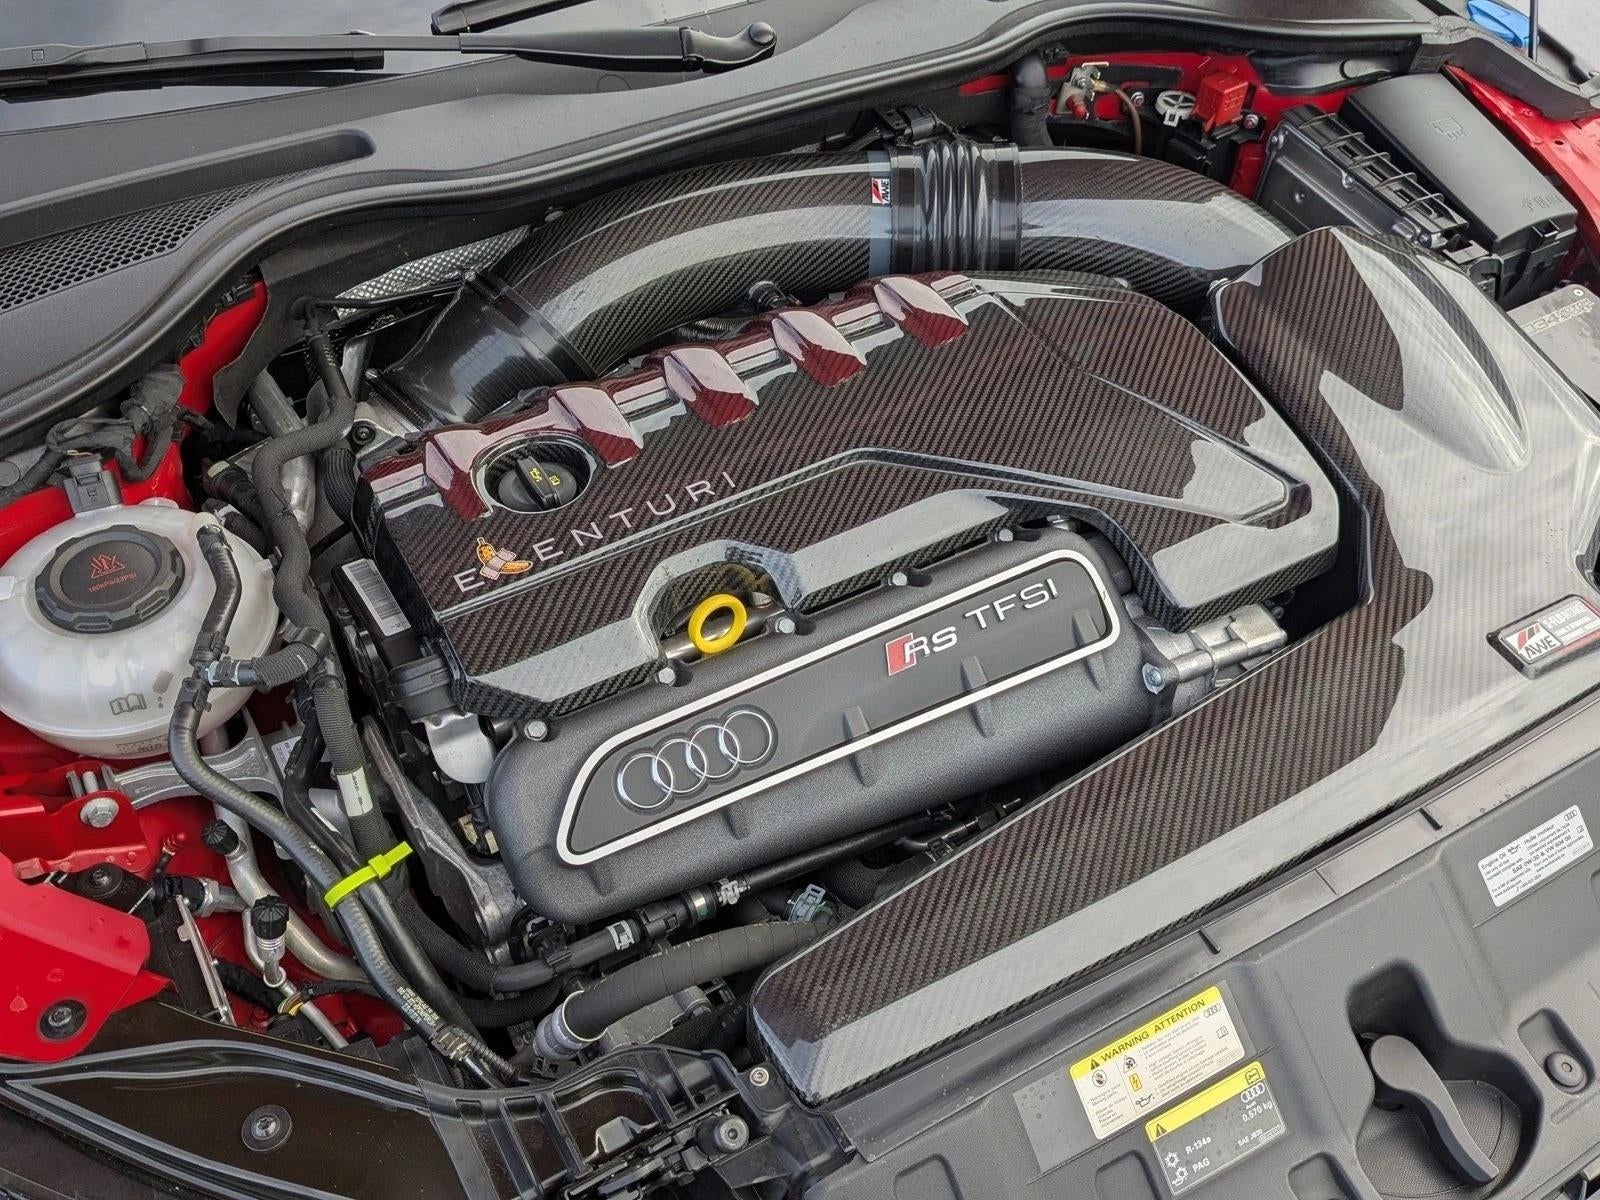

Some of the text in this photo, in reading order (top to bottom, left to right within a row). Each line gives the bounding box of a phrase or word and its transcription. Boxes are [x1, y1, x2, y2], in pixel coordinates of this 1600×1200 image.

[453, 471, 736, 592] EENTURI
[902, 577, 1059, 664] RS TFSI
[1523, 635, 1557, 659] AWE
[1481, 851, 1507, 870] Engine Oil
[1512, 864, 1523, 874] SAE
[1101, 1032, 1150, 1062] WARNING
[1154, 998, 1206, 1033] ATTENTION
[1263, 1101, 1274, 1110] kg
[1185, 1136, 1212, 1155] R-134a
[1237, 1136, 1249, 1147] SAE
[1192, 1157, 1211, 1173] PAG
